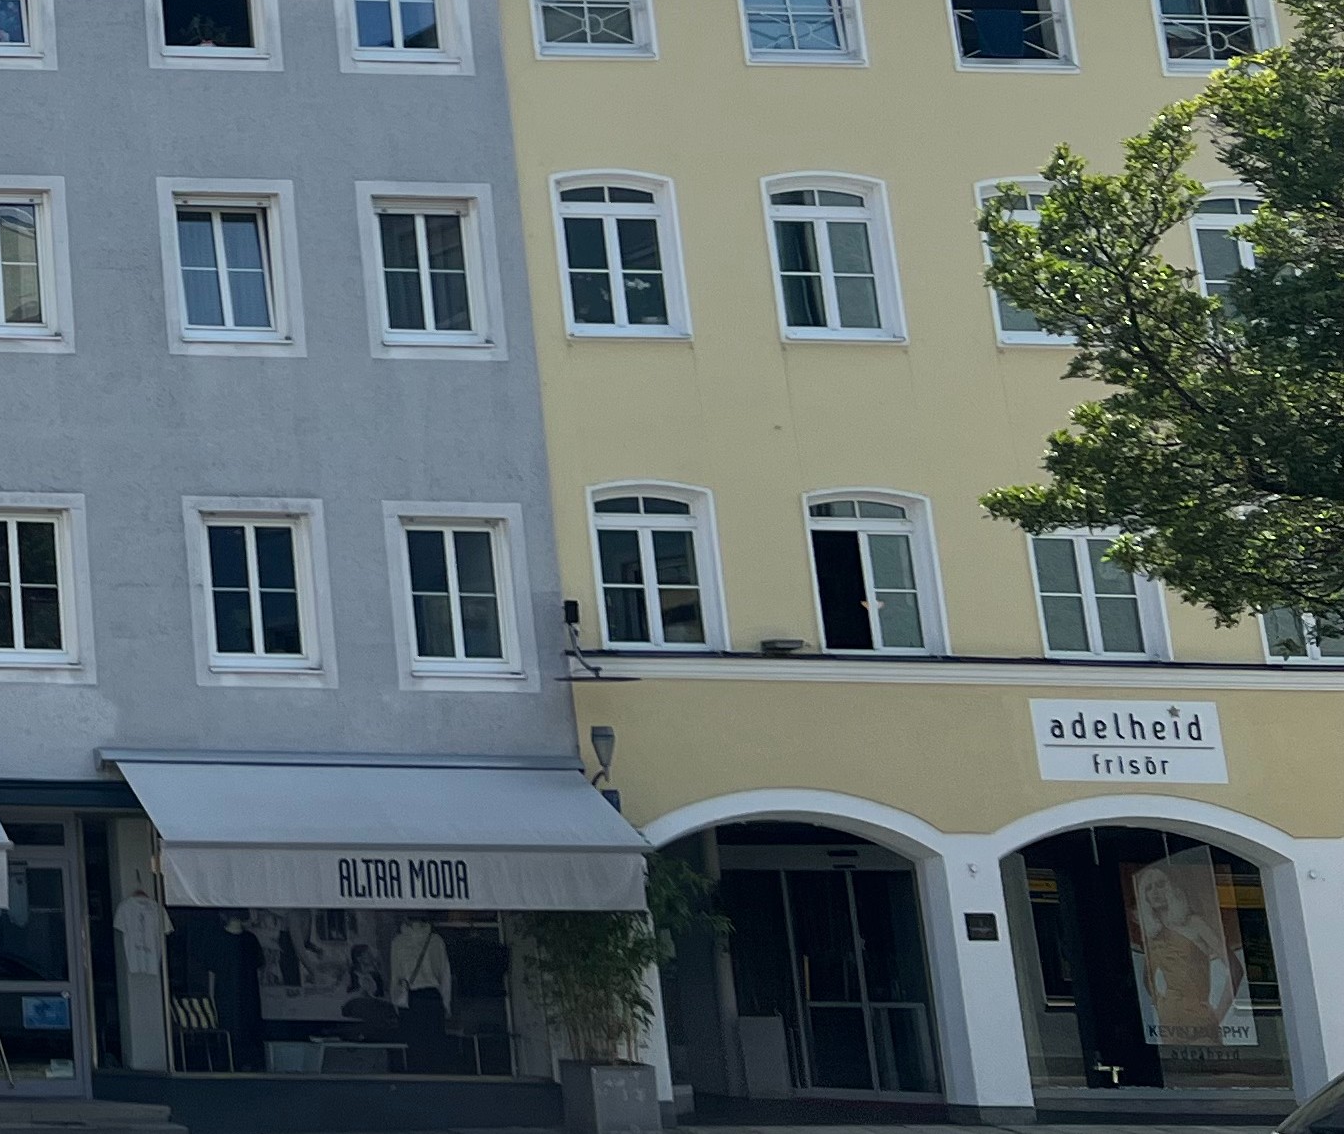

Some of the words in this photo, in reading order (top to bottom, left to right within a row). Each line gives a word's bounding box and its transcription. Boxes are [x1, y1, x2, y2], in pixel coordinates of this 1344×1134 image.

[1050, 710, 1203, 742] adelheid
[1092, 753, 1169, 776] frisör
[338, 858, 403, 900] ALTRA
[408, 859, 470, 900] MODA
